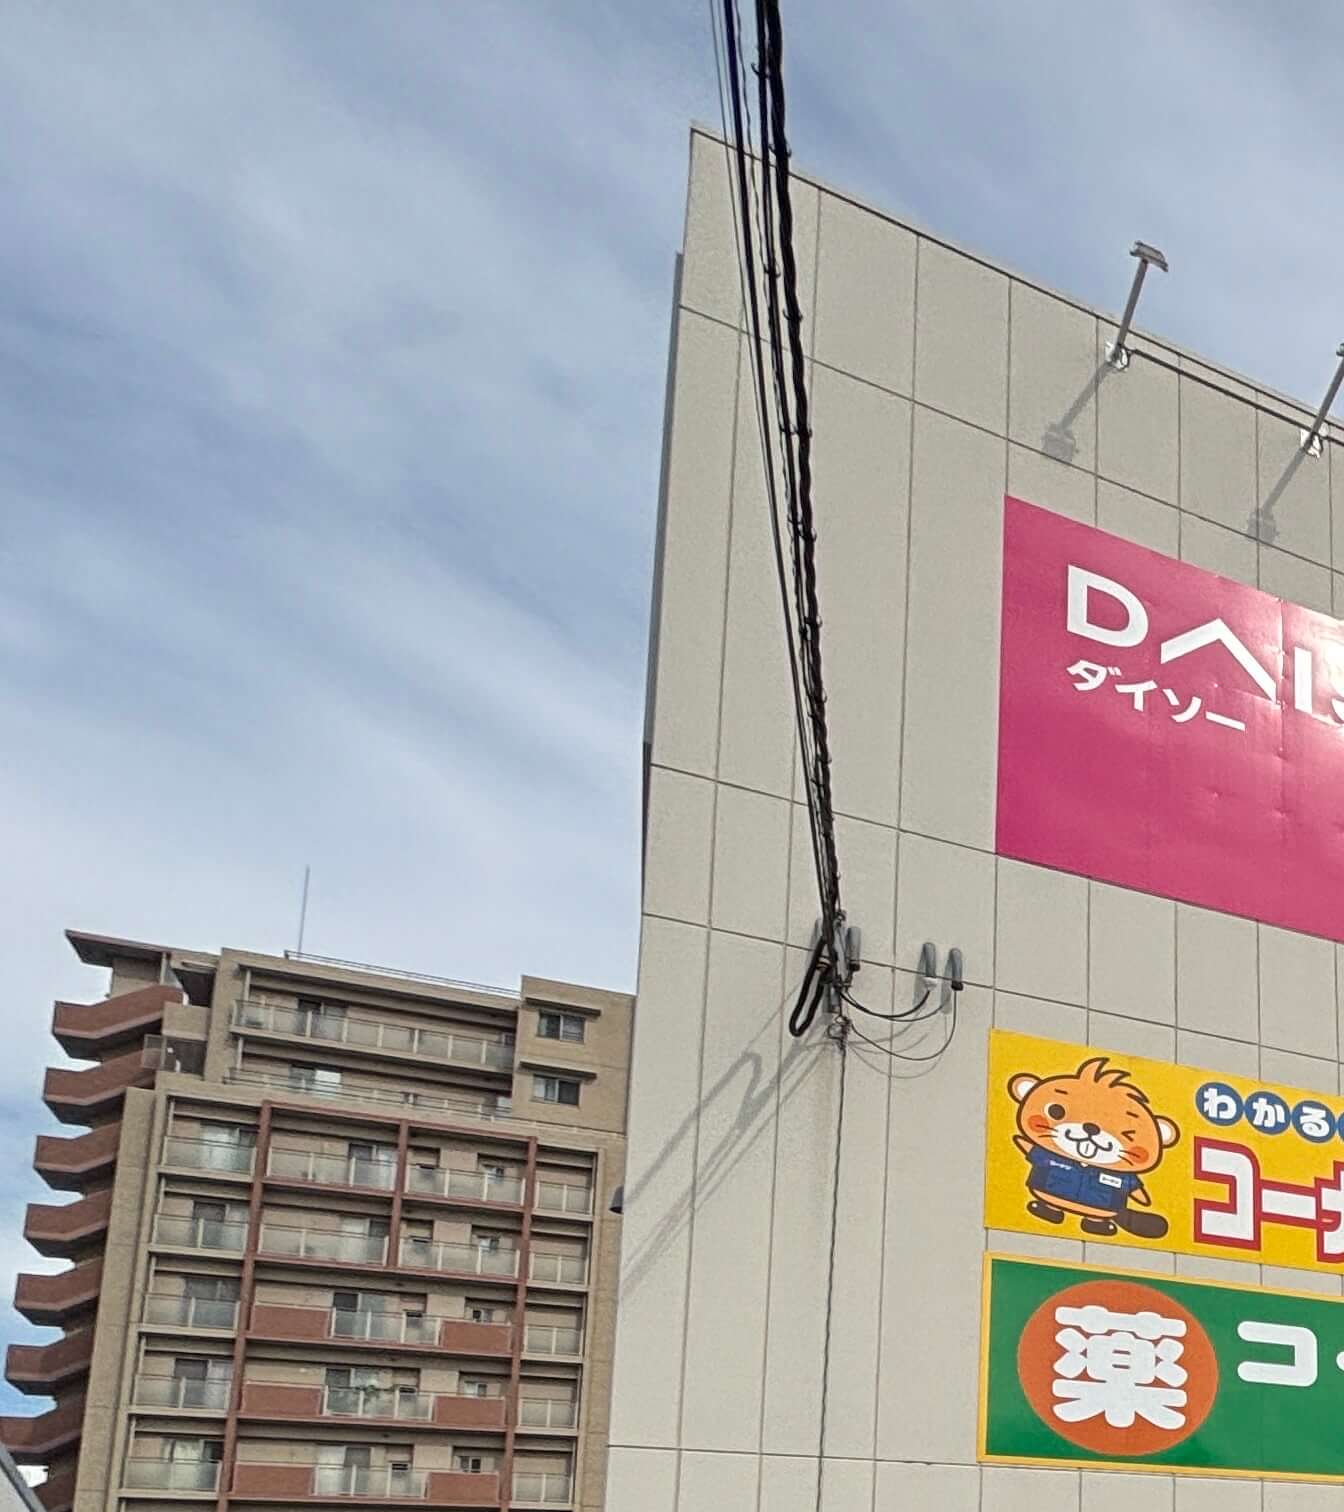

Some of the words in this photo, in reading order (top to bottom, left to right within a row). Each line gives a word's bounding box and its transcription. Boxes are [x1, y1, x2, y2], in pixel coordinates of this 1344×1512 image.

[1066, 659, 1246, 734] ダイソー
[1053, 1304, 1188, 1432] 薬
